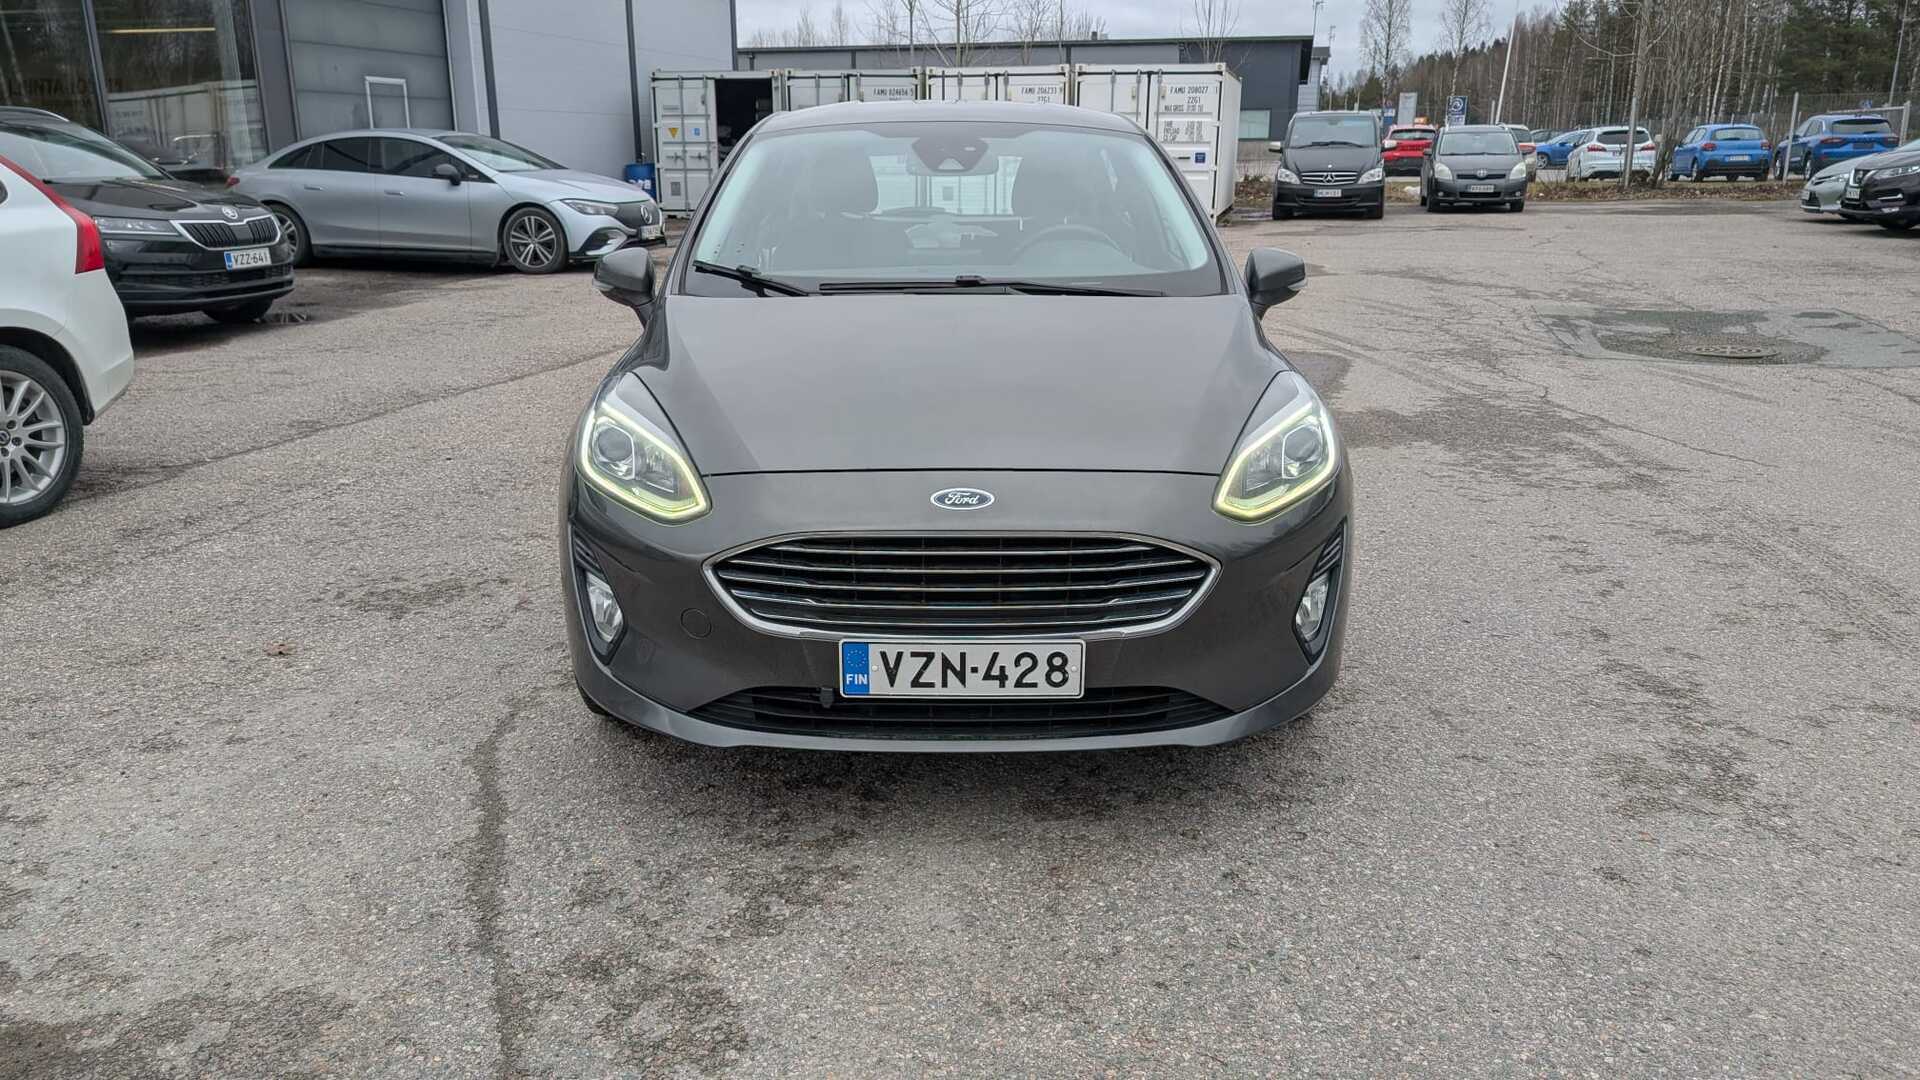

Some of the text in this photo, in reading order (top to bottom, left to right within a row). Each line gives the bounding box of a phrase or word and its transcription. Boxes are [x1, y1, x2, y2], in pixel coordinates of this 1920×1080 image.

[1170, 85, 1186, 94] FAMU
[233, 251, 268, 265] VZZ-641
[944, 491, 980, 504] Ford
[879, 650, 1070, 689] VZN-428
[846, 673, 868, 685] FIN
